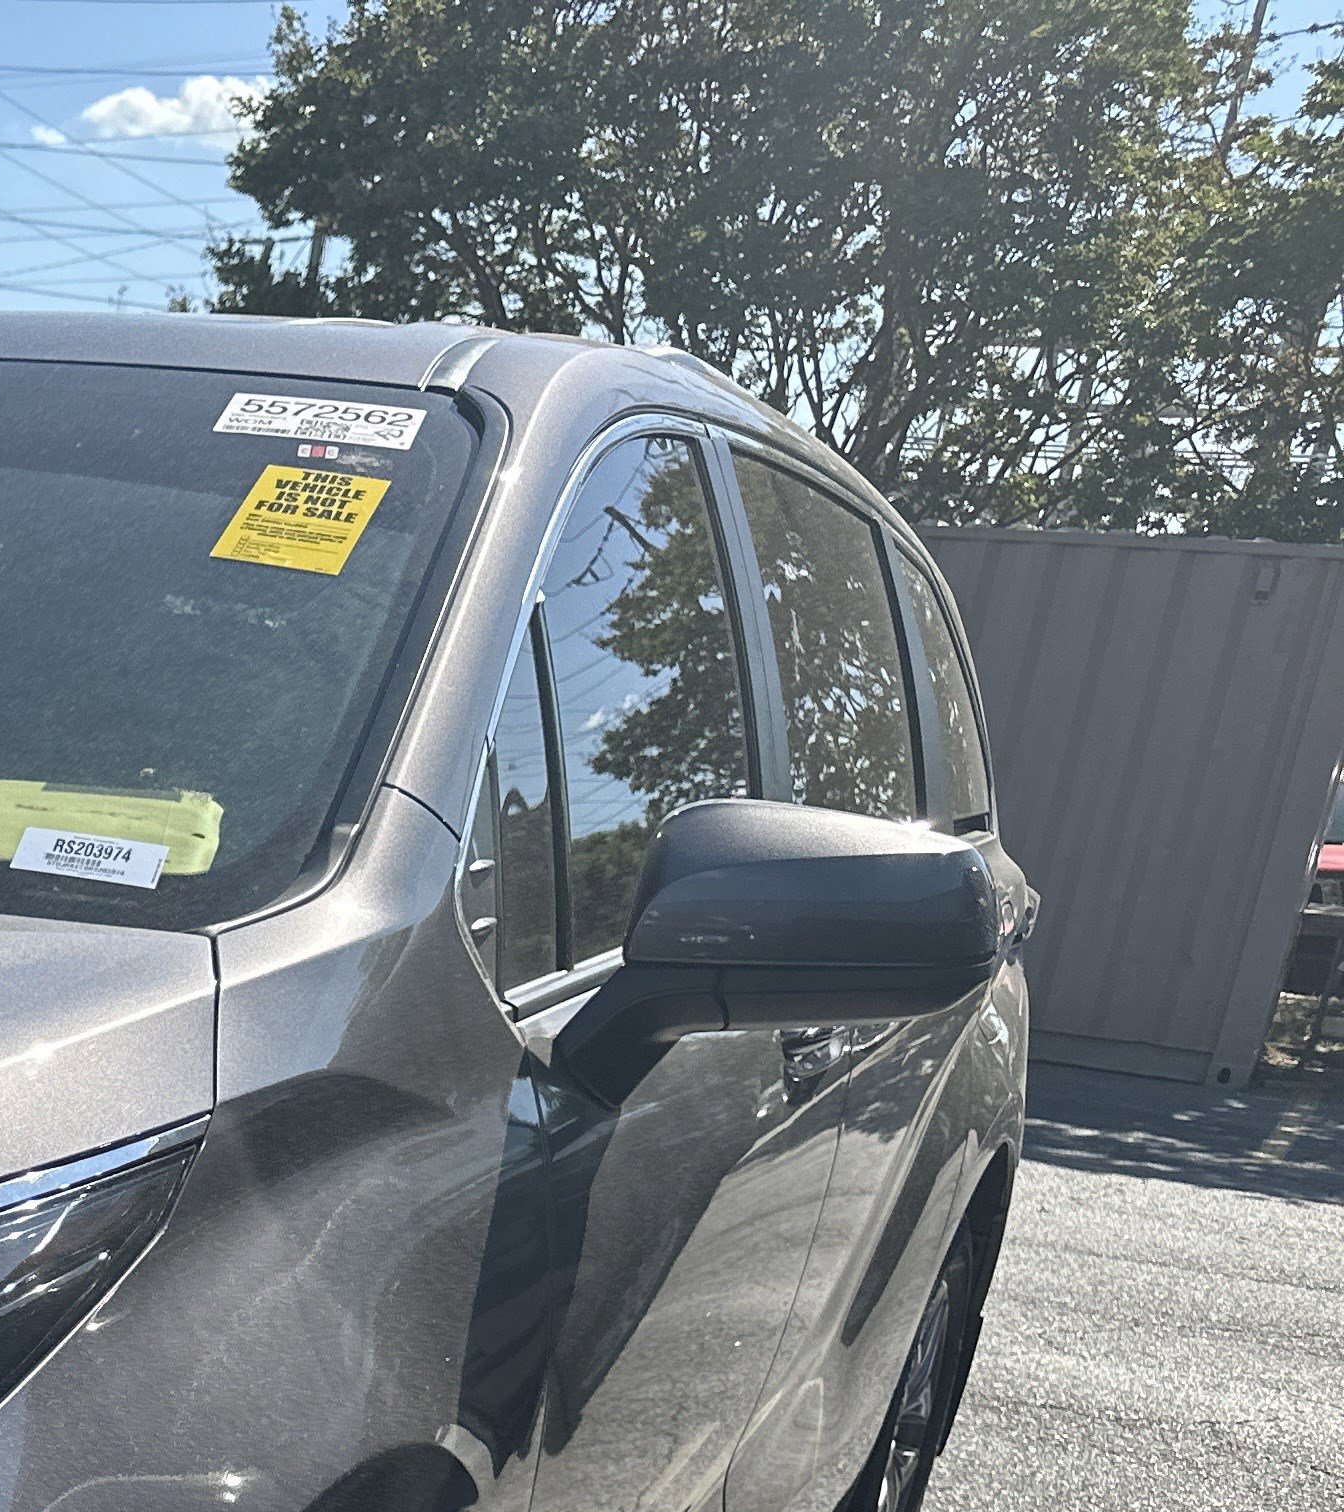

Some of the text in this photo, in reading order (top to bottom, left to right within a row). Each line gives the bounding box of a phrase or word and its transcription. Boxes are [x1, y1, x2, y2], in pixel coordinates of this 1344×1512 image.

[239, 398, 413, 428] 5572562
[275, 478, 367, 501] VEHICLE
[301, 470, 353, 487] THIS
[275, 490, 352, 510] IS NOT
[254, 500, 300, 516] FOR
[302, 506, 359, 524] SALE
[52, 838, 133, 863] RS203974
